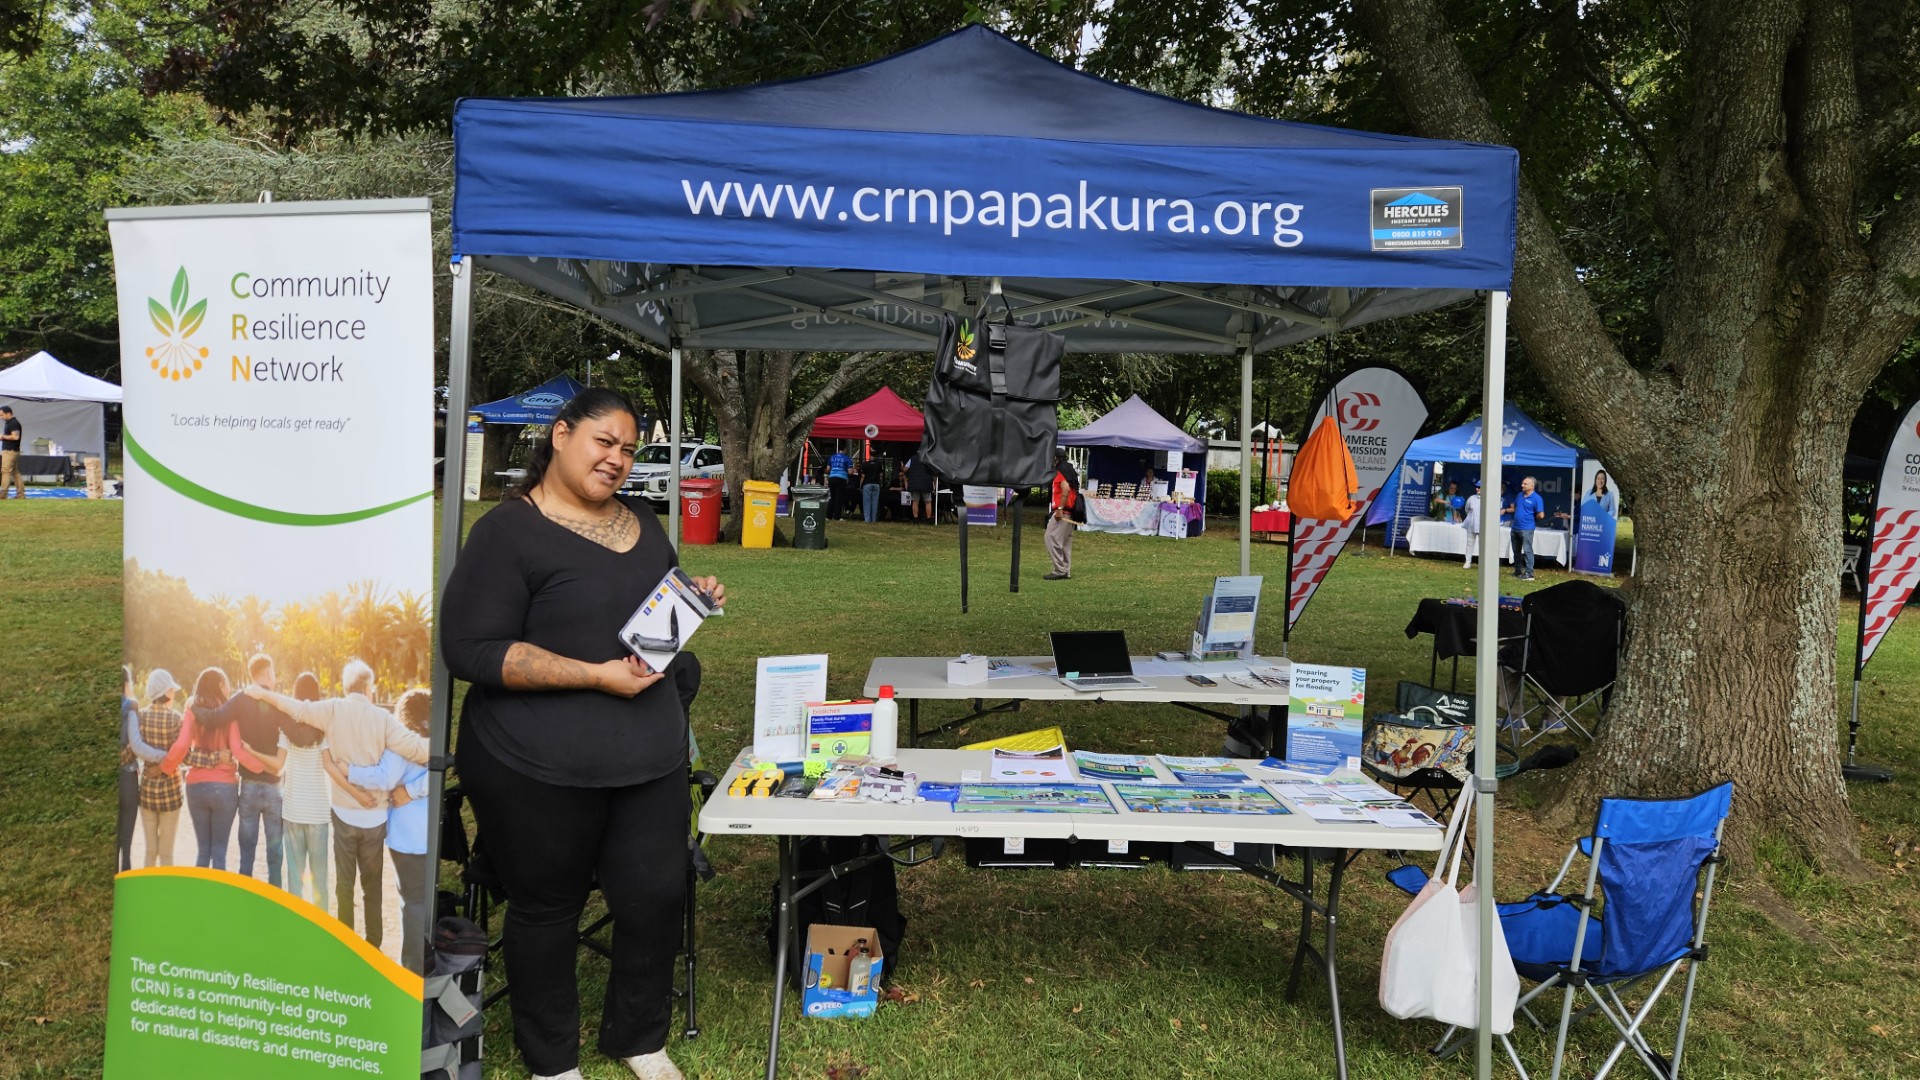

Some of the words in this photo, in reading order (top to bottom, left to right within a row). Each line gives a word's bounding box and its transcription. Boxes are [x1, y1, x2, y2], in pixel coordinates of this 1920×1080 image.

[681, 179, 1305, 249] www.crnpapakura.org
[1384, 205, 1449, 218] HERCULES
[1412, 230, 1426, 238] 810
[230, 269, 390, 304] Community
[231, 313, 366, 341] Resilience
[231, 355, 343, 382] Network
[213, 415, 256, 430] helping
[259, 416, 293, 430] locals
[294, 418, 312, 432] get
[1343, 434, 1388, 447] MMERCE
[1296, 668, 1328, 678] Preparing
[1311, 677, 1340, 686] property
[1305, 683, 1333, 692] flooding
[130, 956, 156, 975] The
[158, 961, 240, 990] Community
[243, 972, 310, 998] Resilience
[314, 985, 372, 1010] Network
[130, 977, 171, 998] (CRN)
[173, 983, 184, 998] is
[186, 988, 196, 1000] a
[198, 990, 303, 1018] community-led
[305, 1008, 348, 1028] group
[807, 1001, 843, 1015] OREO
[130, 998, 196, 1021] dedicated
[199, 1008, 215, 1024] to
[217, 1011, 267, 1036] helping
[270, 1022, 332, 1043] residents
[335, 1034, 388, 1055] prepare
[130, 1016, 150, 1033] for
[153, 1023, 199, 1041] natural
[201, 1030, 259, 1052] disasters
[262, 1041, 288, 1057] and
[291, 1047, 384, 1075] emergencies.
